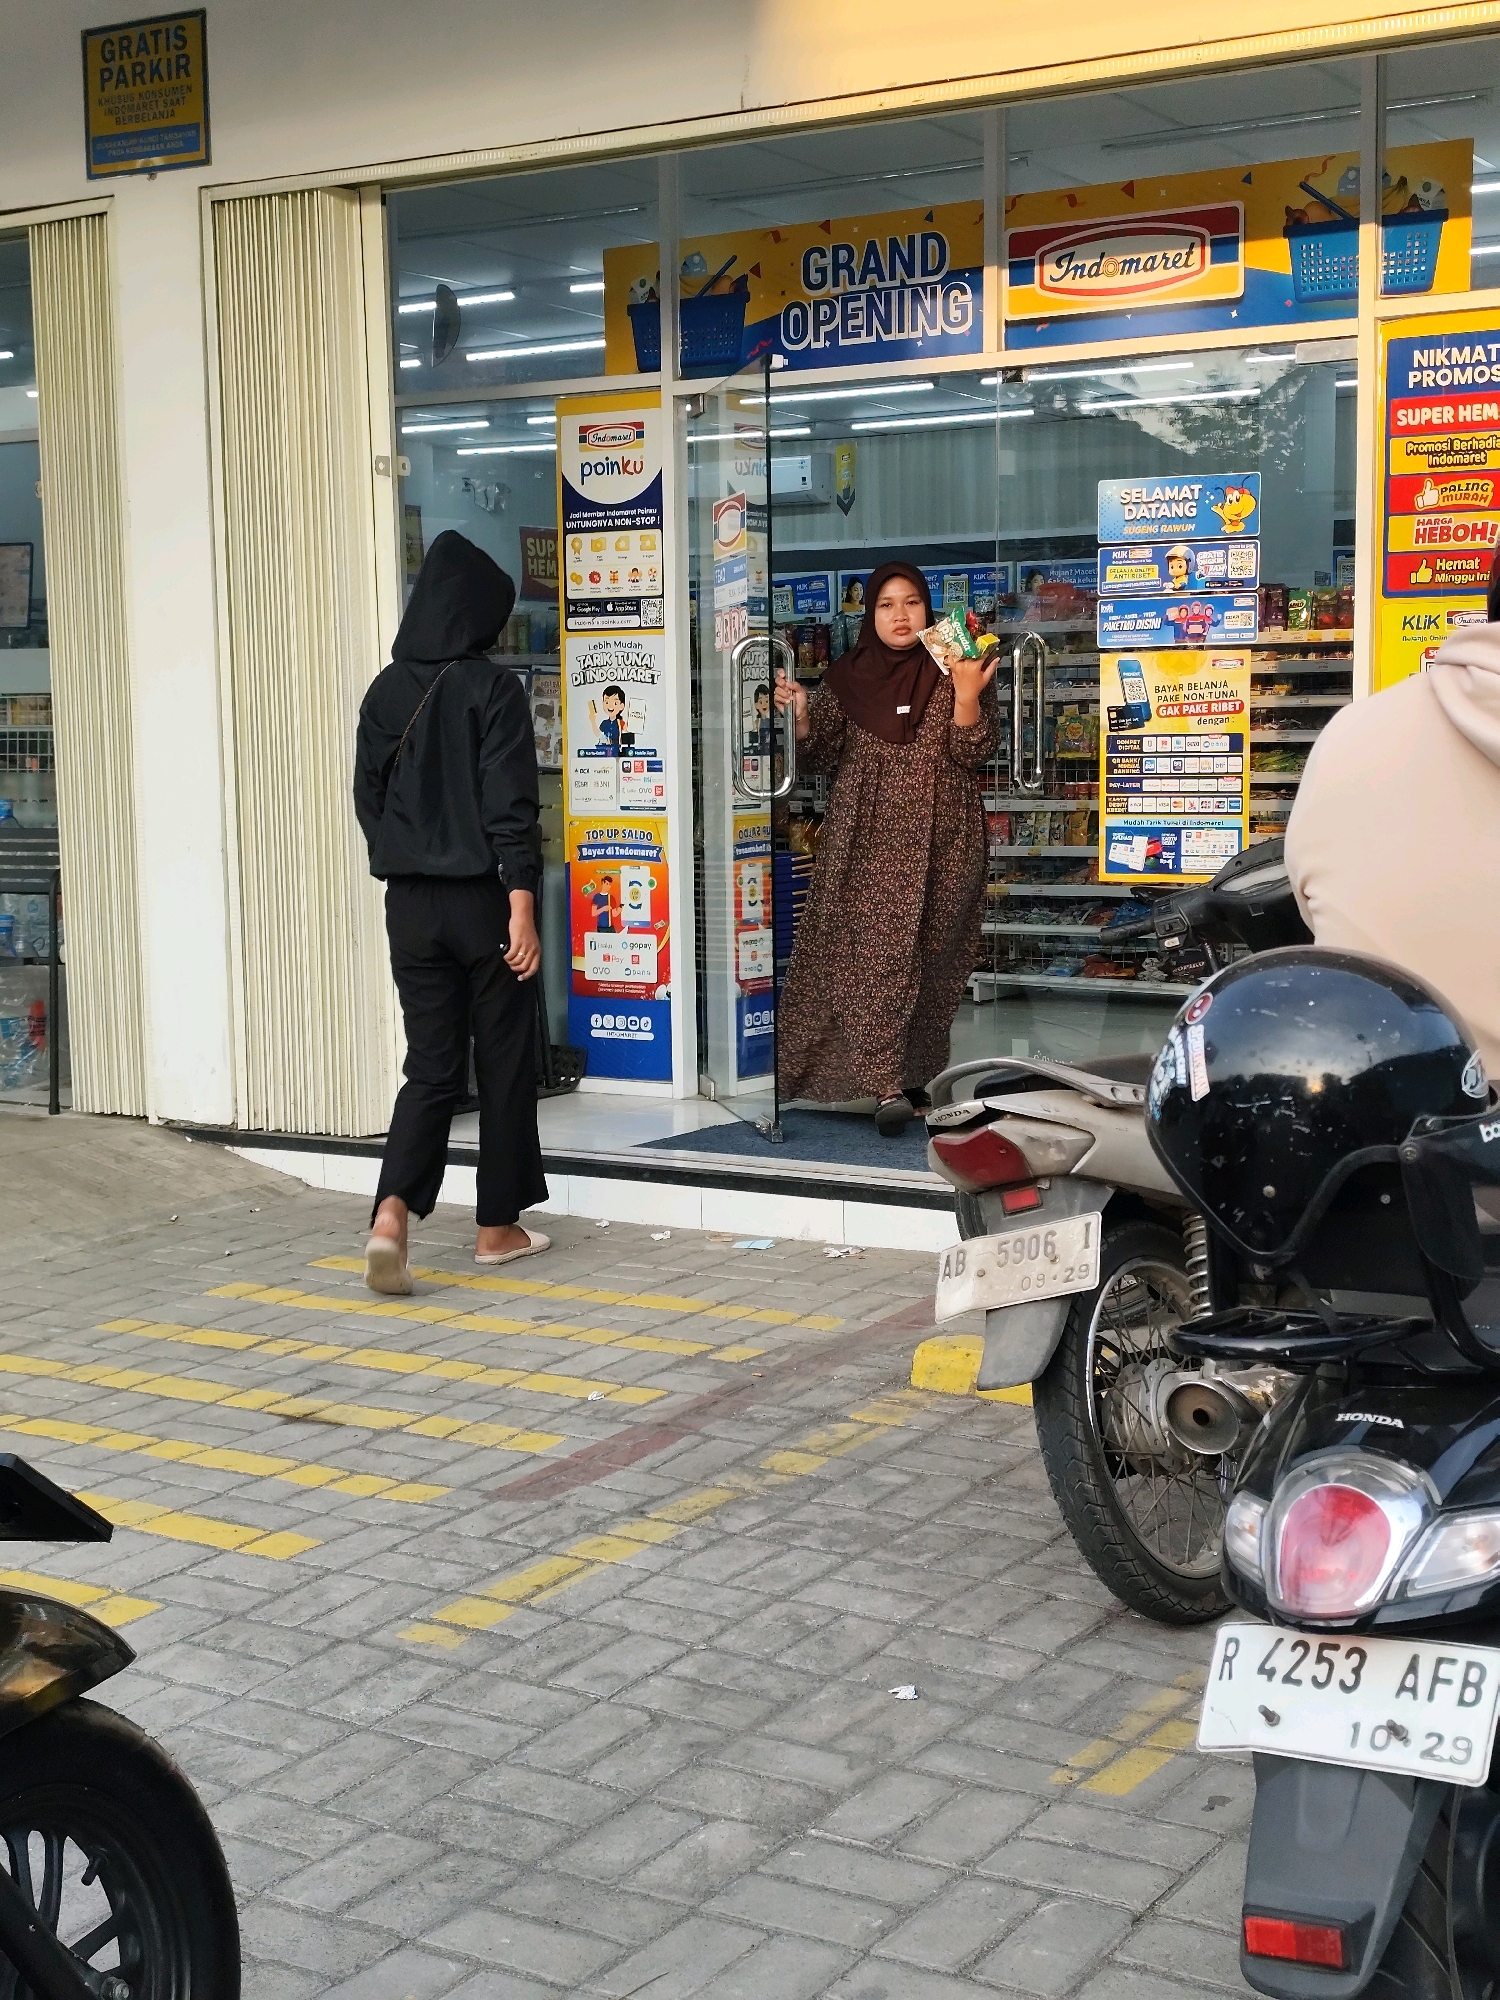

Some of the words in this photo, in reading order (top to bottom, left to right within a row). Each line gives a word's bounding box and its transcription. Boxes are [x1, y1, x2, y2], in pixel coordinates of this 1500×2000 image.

[101, 25, 188, 64] GRATIS
[100, 53, 191, 92] PARKIR
[98, 92, 135, 107] KHUSUS
[138, 84, 193, 102] KONSUMEN
[104, 99, 160, 117] INDOMARET
[163, 96, 187, 108] SAAT
[115, 108, 176, 126] BERBELANJA
[802, 231, 950, 296] GRAND
[1050, 242, 1196, 283] Indomaret
[781, 282, 973, 351] OPENING
[1396, 405, 1455, 427] SUPER
[1458, 402, 1500, 423] HEM
[591, 431, 632, 444] Indomaret
[1406, 437, 1451, 456] Promosi
[1428, 451, 1487, 468] Indomaret
[580, 455, 644, 486] poinku
[1120, 484, 1203, 504] SELAMAT
[1440, 482, 1490, 495] PALING
[1441, 492, 1490, 504] MURAH
[582, 510, 606, 518] Member
[606, 508, 637, 517] Indomaret
[1124, 501, 1197, 521] DATANG
[566, 518, 614, 529] UNTUNGNYA
[614, 516, 656, 527] NON-STOP
[1123, 524, 1159, 535] SUGENG
[1160, 523, 1196, 533] RAWUH
[1416, 517, 1453, 527] HARGA
[1414, 521, 1498, 545] HEBOH!
[526, 537, 559, 558] SUP
[1197, 551, 1225, 559] GRATIS
[1436, 557, 1480, 571] Hemat
[1050, 568, 1073, 577] Hujan?
[1077, 576, 1098, 584] kelua
[1435, 571, 1475, 584] Minggu
[1476, 570, 1490, 582] Ini
[1135, 617, 1162, 630] DISINI
[952, 621, 971, 651] garuda
[588, 641, 612, 651] Lebih
[614, 640, 643, 651] Mudah
[576, 651, 613, 670] TARIK
[614, 651, 655, 670] TUNAI
[583, 666, 662, 686] INDOMARET
[1154, 683, 1184, 693] BAYAR
[1187, 680, 1229, 691] BELANJA
[1157, 694, 1180, 703] PAKE
[1183, 690, 1238, 702] NON-TUNAI
[1159, 705, 1180, 716] GAK
[1182, 703, 1208, 714] PAKE
[1211, 701, 1242, 712] RIBET
[1197, 716, 1230, 726] dengan
[585, 829, 604, 841] TOP
[605, 828, 620, 840] UP
[621, 829, 654, 842] SALDO
[582, 847, 606, 858] Bayar
[606, 846, 614, 855] di
[629, 942, 652, 950] gopay
[592, 966, 611, 975] OVO
[934, 1108, 971, 1123] HONDA
[942, 1248, 967, 1282] AB
[996, 1229, 1058, 1268] 5906
[1336, 1412, 1405, 1429] HONDA
[1218, 1637, 1241, 1682] R
[1256, 1637, 1369, 1695] 4253
[1395, 1653, 1488, 1708] AFB
